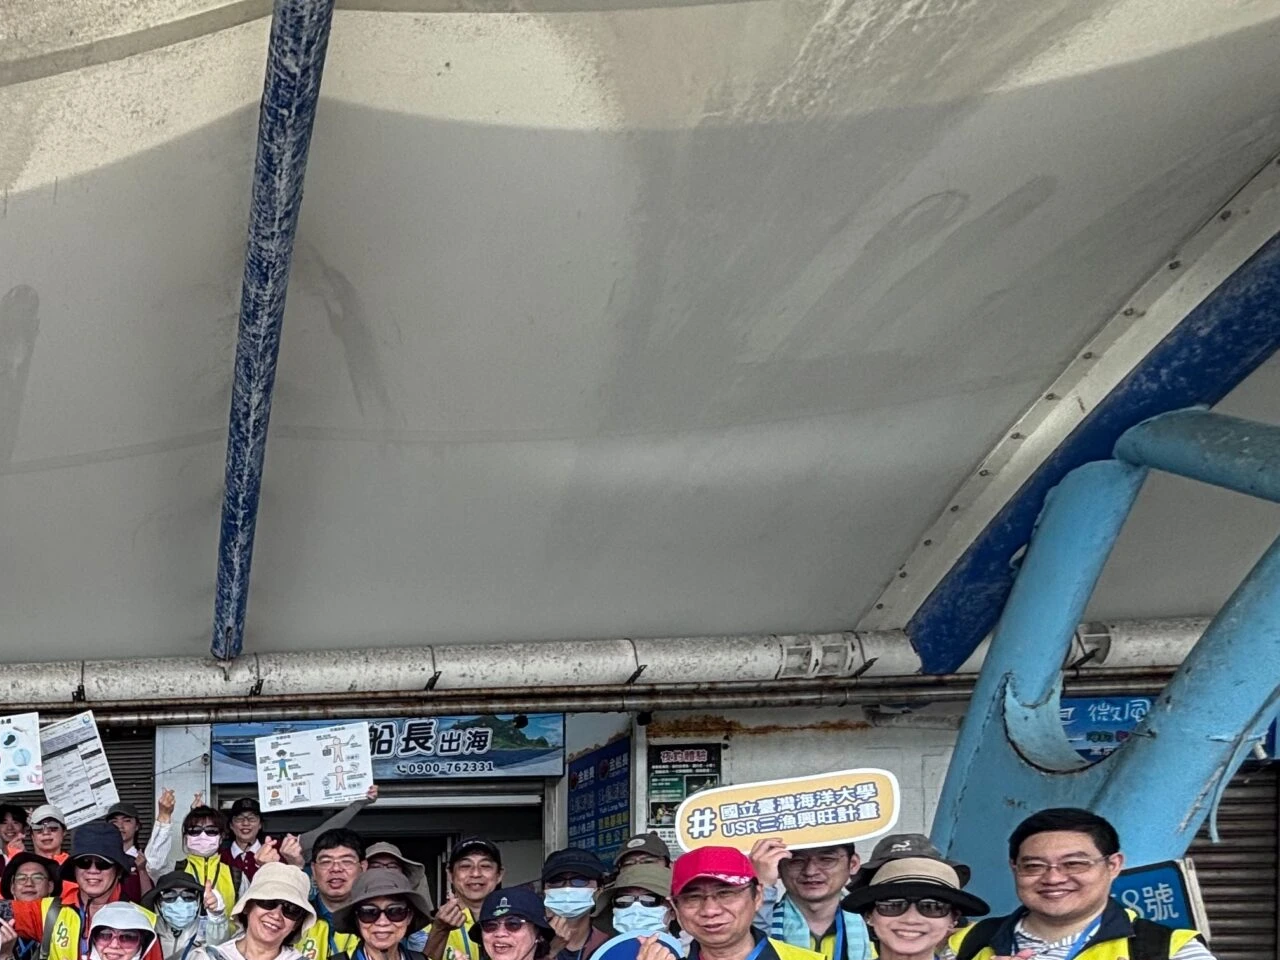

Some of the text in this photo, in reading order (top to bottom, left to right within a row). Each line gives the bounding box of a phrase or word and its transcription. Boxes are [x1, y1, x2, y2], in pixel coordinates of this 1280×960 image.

[368, 720, 491, 757] 船長出海
[409, 762, 494, 773] 0900-762331
[719, 782, 879, 822] 國立臺灣海洋大學
[721, 801, 880, 838] USR三漁興旺計畫
[1111, 883, 1179, 922] 8號
